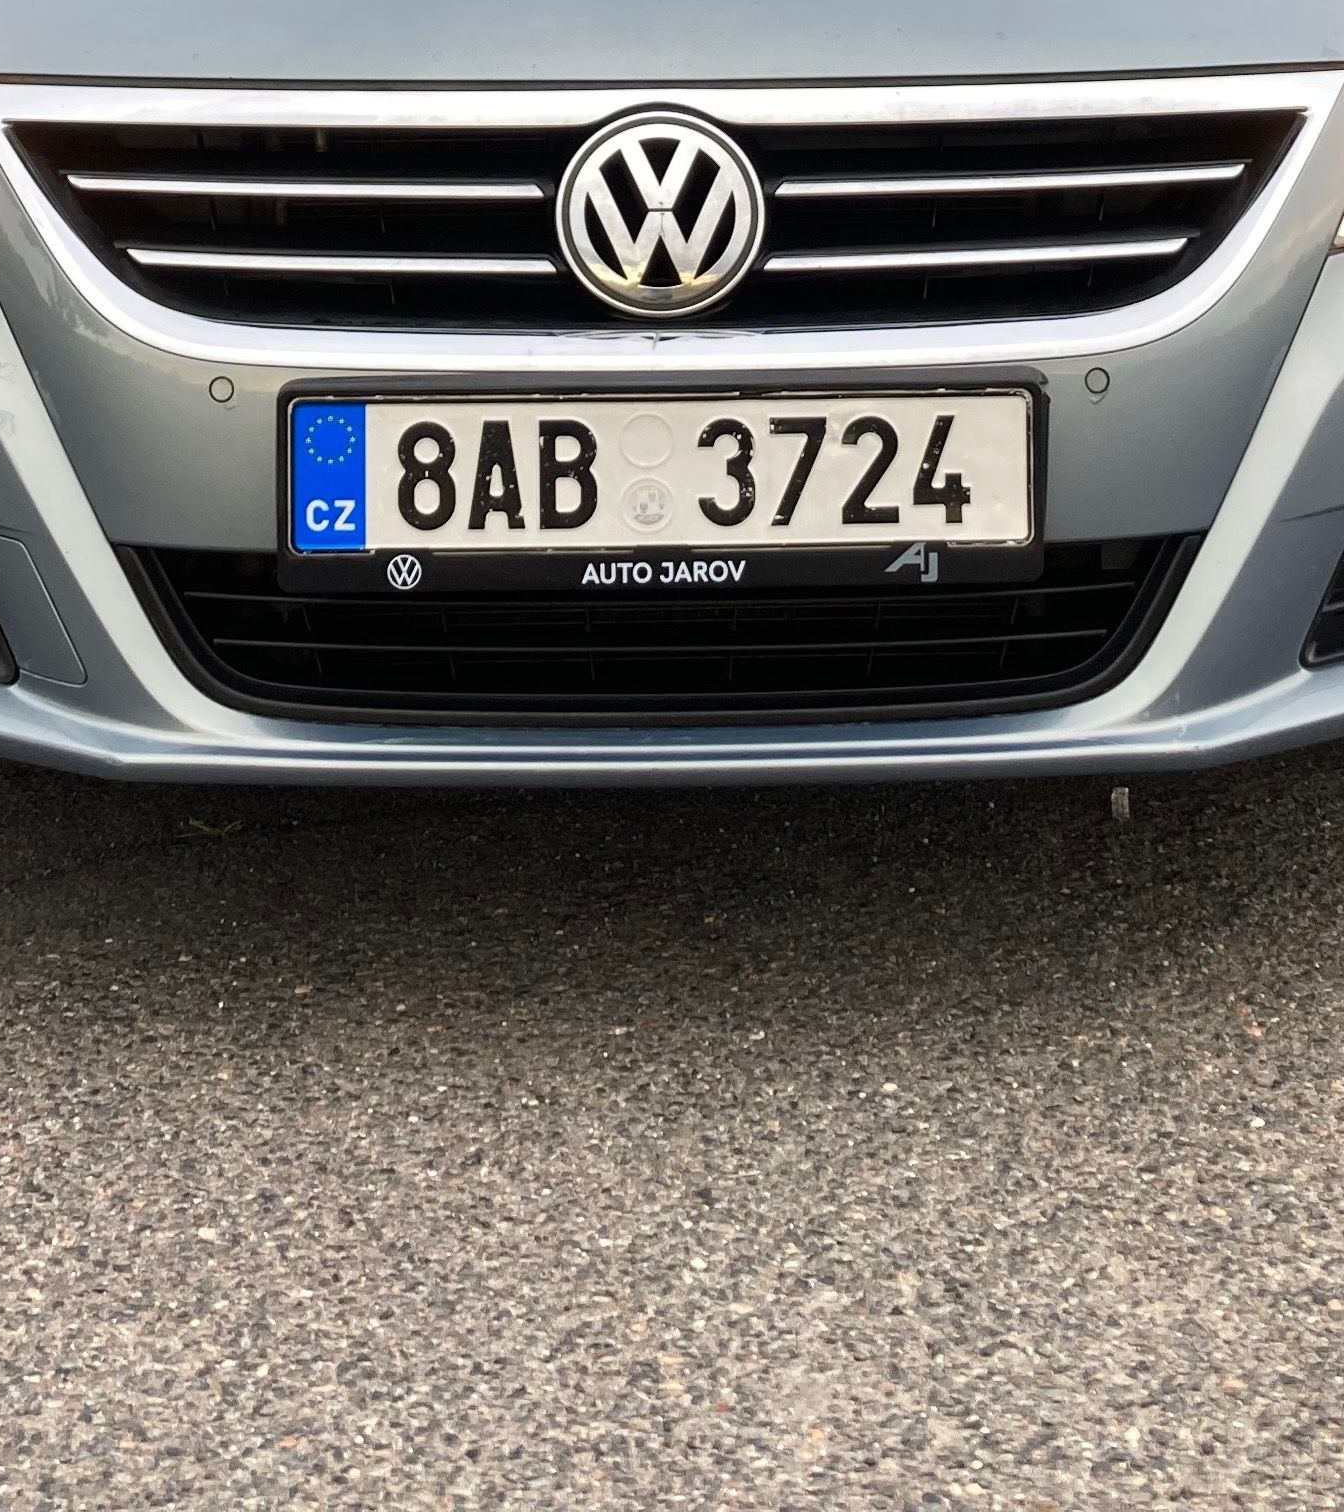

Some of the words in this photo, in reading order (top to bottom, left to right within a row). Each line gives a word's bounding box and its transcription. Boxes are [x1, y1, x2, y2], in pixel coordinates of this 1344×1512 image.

[566, 120, 754, 306] VW
[397, 419, 598, 531] 8AB
[697, 414, 971, 527] 3724
[305, 499, 356, 532] CZ
[387, 554, 422, 589] VW
[581, 561, 653, 585] AUTO
[659, 560, 747, 583] JAROV
